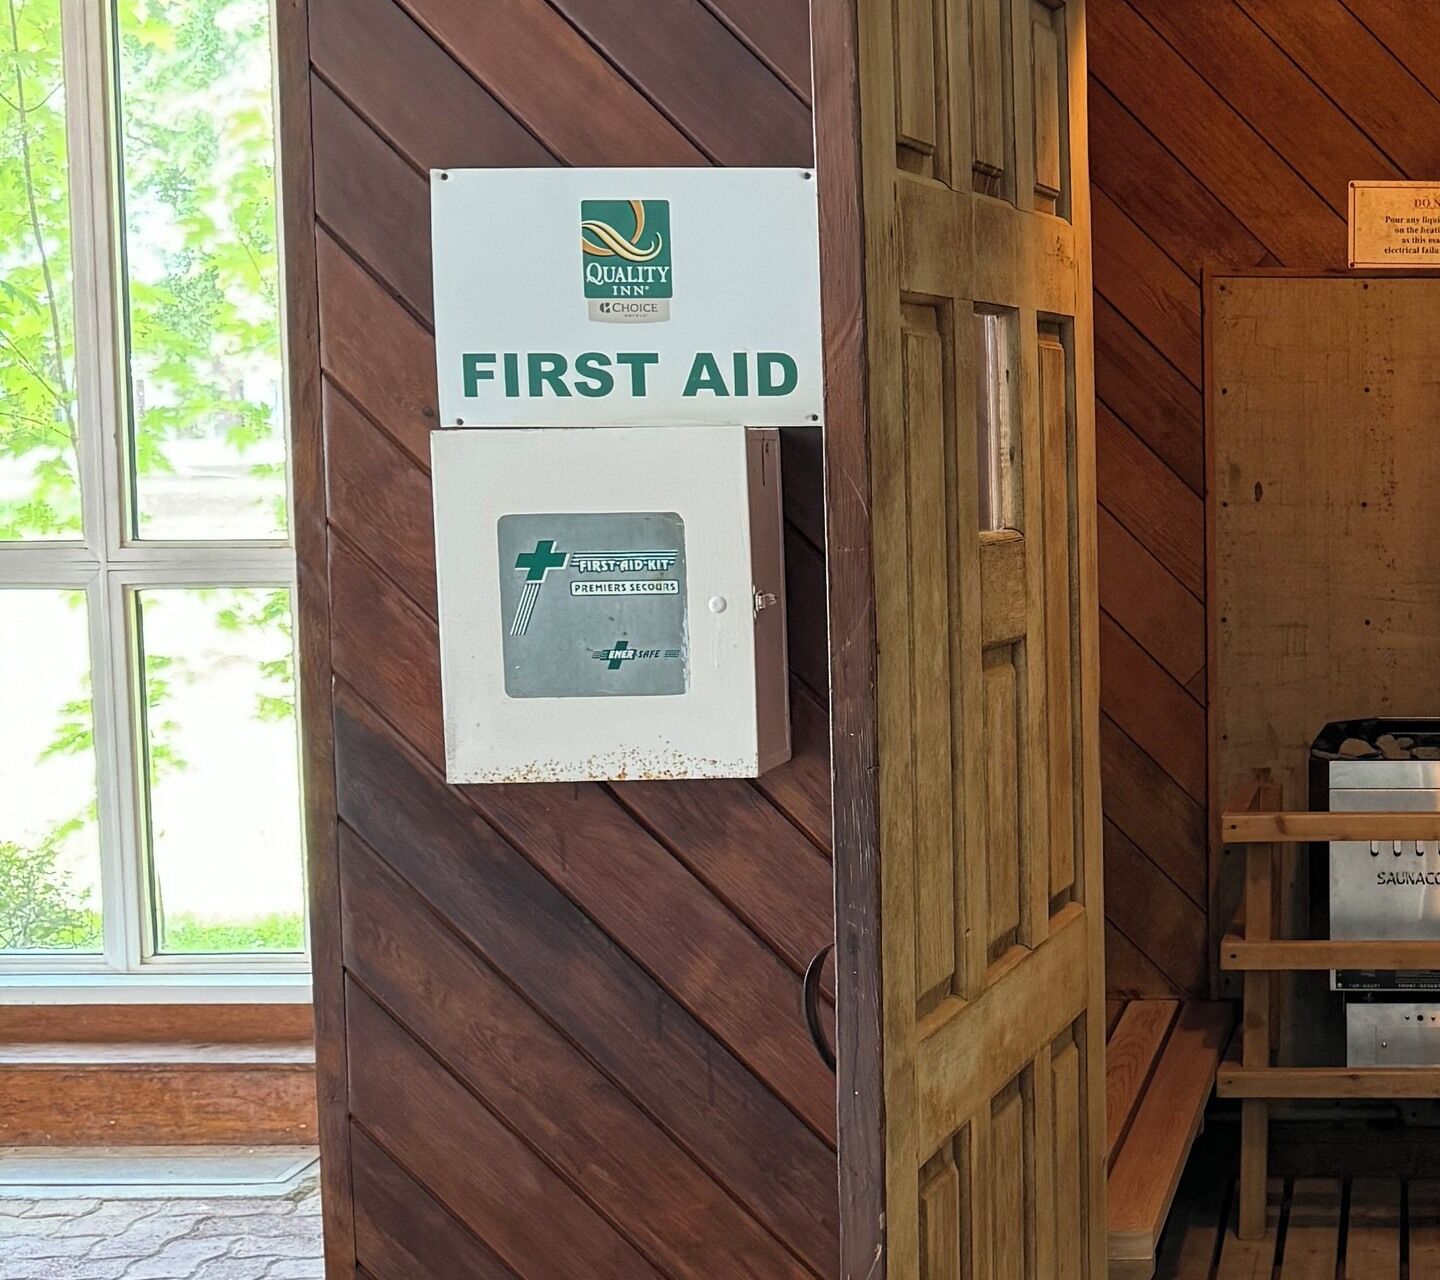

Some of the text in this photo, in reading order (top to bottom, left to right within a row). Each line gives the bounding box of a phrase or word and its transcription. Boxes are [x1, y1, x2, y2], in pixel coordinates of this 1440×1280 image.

[1413, 198, 1430, 208] DO
[1385, 216, 1403, 224] Pour
[1405, 218, 1419, 226] any
[1406, 226, 1419, 234] the
[1411, 236, 1427, 244] this
[1384, 246, 1420, 254] electrical
[586, 262, 670, 285] QUALITY
[612, 302, 659, 313] CHOICE
[462, 352, 799, 398] FIRST AID
[574, 582, 676, 593] PREMIERS SECOURS
